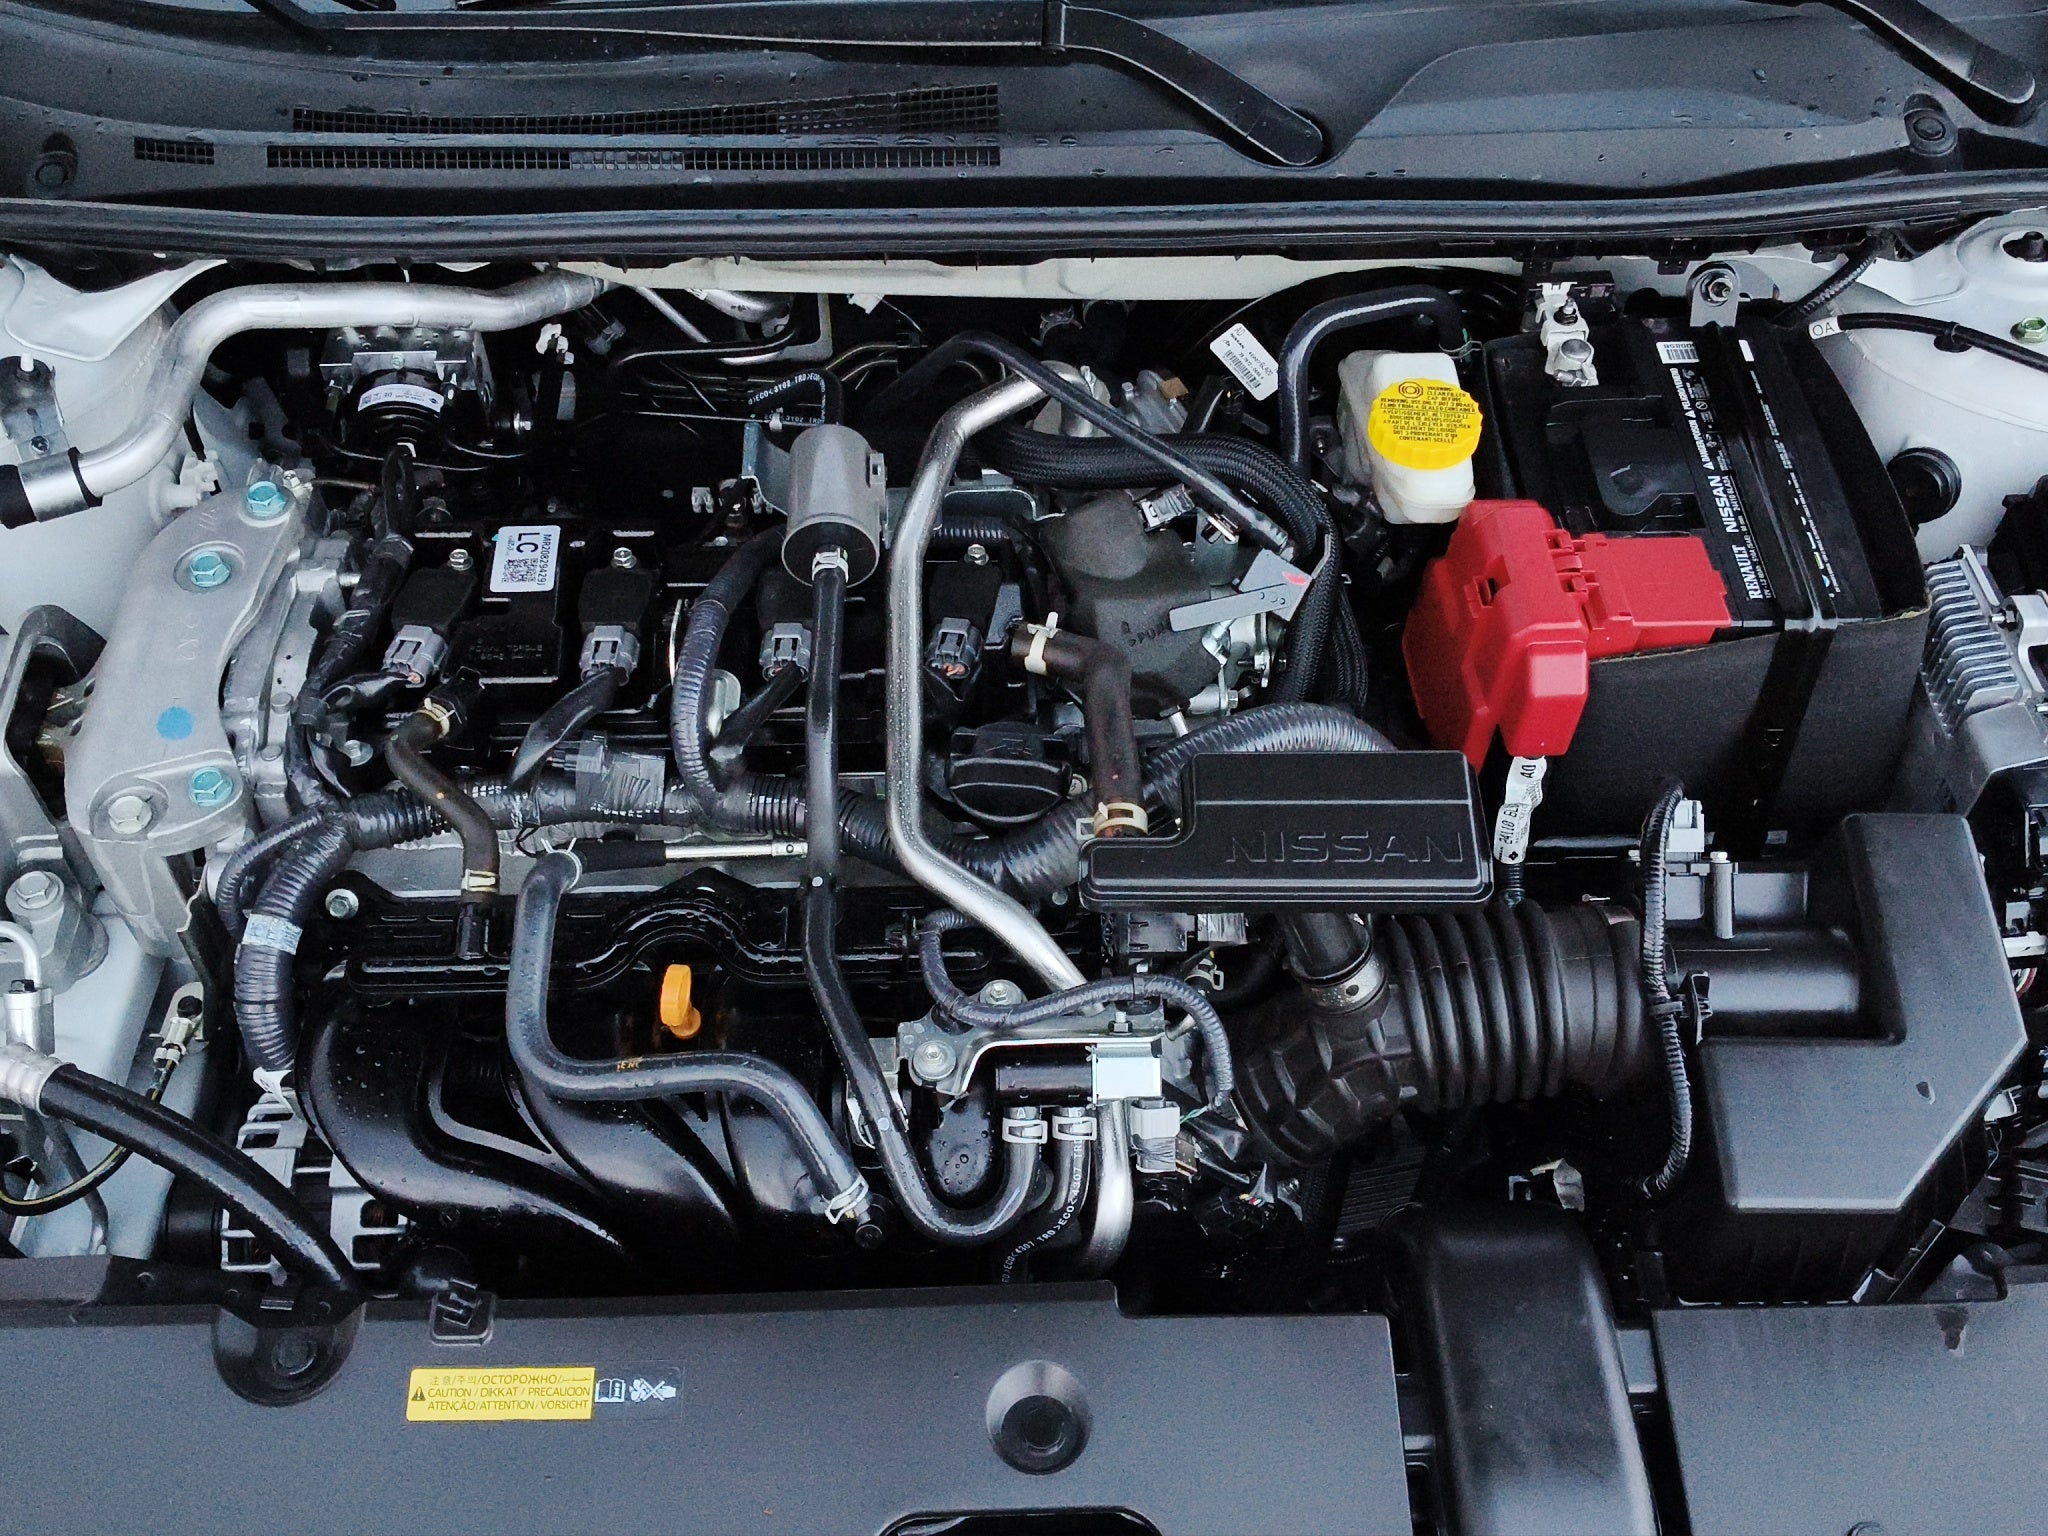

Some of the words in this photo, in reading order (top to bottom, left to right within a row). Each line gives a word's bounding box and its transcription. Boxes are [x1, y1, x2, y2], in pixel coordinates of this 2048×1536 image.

[1707, 475, 1739, 532] NISSAN
[516, 532, 540, 553] LC
[1731, 544, 1763, 599] RENAULT
[1225, 830, 1463, 864] NISSAN
[427, 1388, 472, 1398] CAUTION
